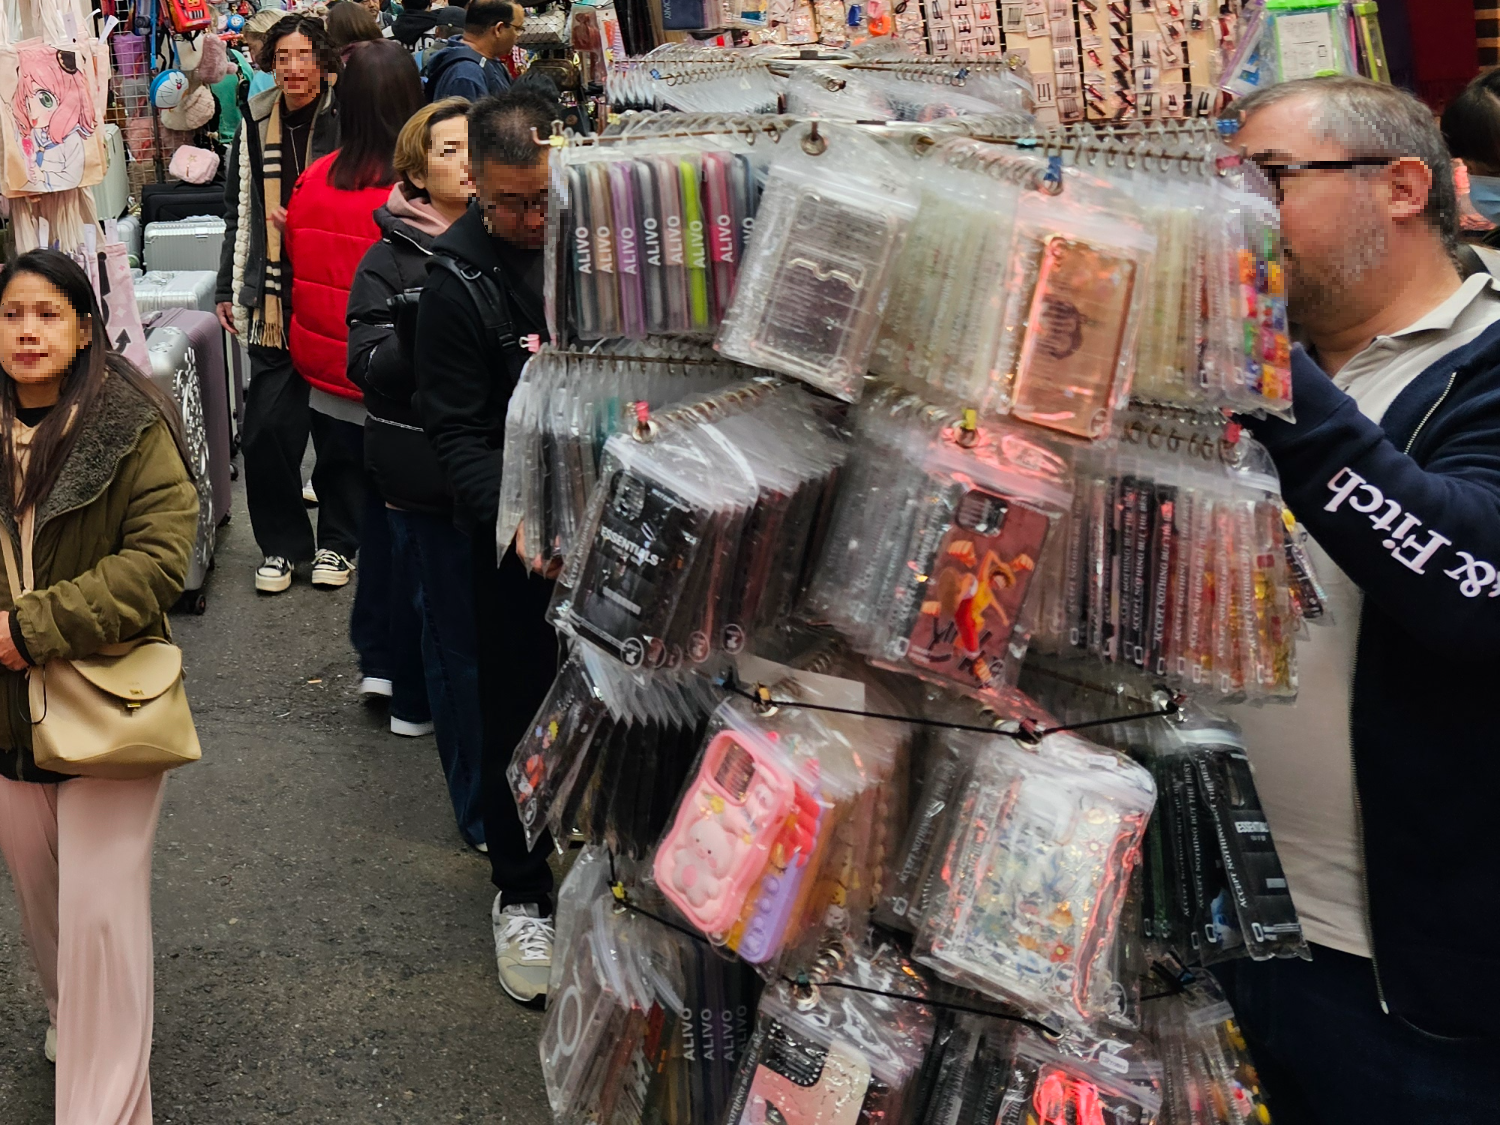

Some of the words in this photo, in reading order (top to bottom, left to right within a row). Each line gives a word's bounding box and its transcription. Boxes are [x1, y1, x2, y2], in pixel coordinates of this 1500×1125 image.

[575, 226, 592, 274] ALIVO
[597, 226, 614, 274] ALIVO
[621, 227, 637, 275] ALIVO
[644, 217, 661, 266] ALIVO
[667, 215, 683, 264] ALIVO
[689, 220, 706, 268] ALIVO
[717, 214, 733, 263] ALIVO
[1323, 467, 1452, 575] Fitch
[601, 525, 659, 566] ESSENTIALS
[1155, 562, 1169, 606] NOTHING
[1443, 551, 1497, 598] &
[1153, 608, 1165, 642] ACCEPT
[1182, 761, 1193, 783] BEST
[1197, 757, 1211, 781] BEST
[1203, 782, 1217, 800] THE
[1185, 785, 1195, 803] THE
[1188, 805, 1198, 824] BUT
[1190, 826, 1202, 871] NOTHING
[1215, 822, 1235, 869] NOTHING
[1229, 870, 1248, 907] ACCEPT
[683, 1007, 696, 1062] ALIVO
[700, 1008, 714, 1062] ALIVO
[721, 1009, 735, 1062] ALIVO
